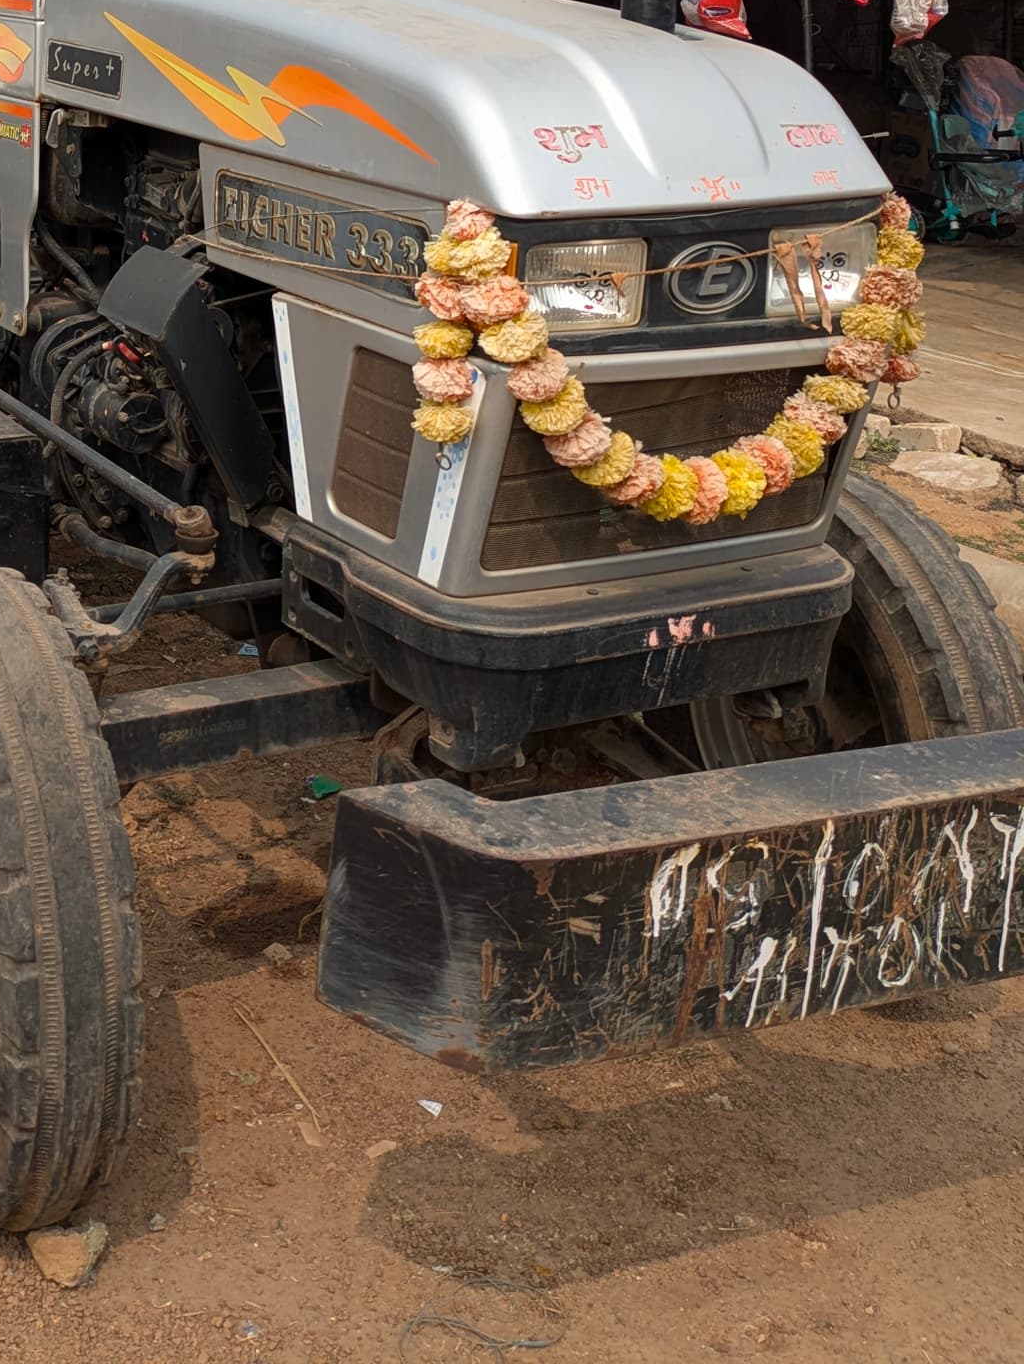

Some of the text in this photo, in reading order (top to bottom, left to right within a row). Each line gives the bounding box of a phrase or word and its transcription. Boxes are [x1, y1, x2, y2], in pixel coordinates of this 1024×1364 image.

[533, 124, 609, 164] शुभ
[779, 123, 845, 149] लाभ
[223, 185, 420, 285] EICHER 333
